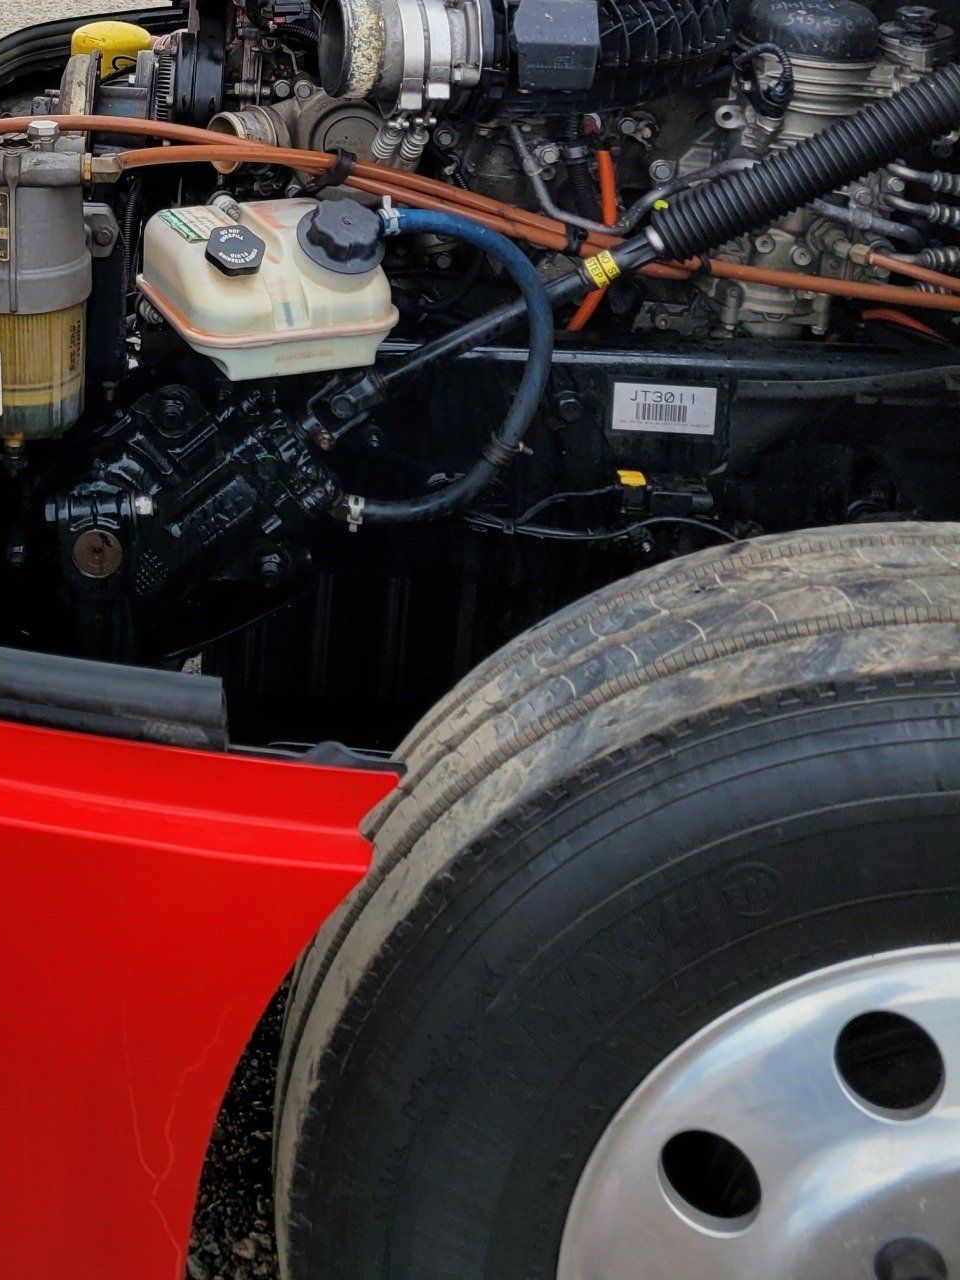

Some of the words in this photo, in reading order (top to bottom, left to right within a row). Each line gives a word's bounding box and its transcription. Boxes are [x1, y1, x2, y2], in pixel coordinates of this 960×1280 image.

[219, 251, 245, 264] STEERING
[600, 252, 610, 264] NO
[586, 259, 603, 278] STEP
[629, 389, 696, 405] JT3011
